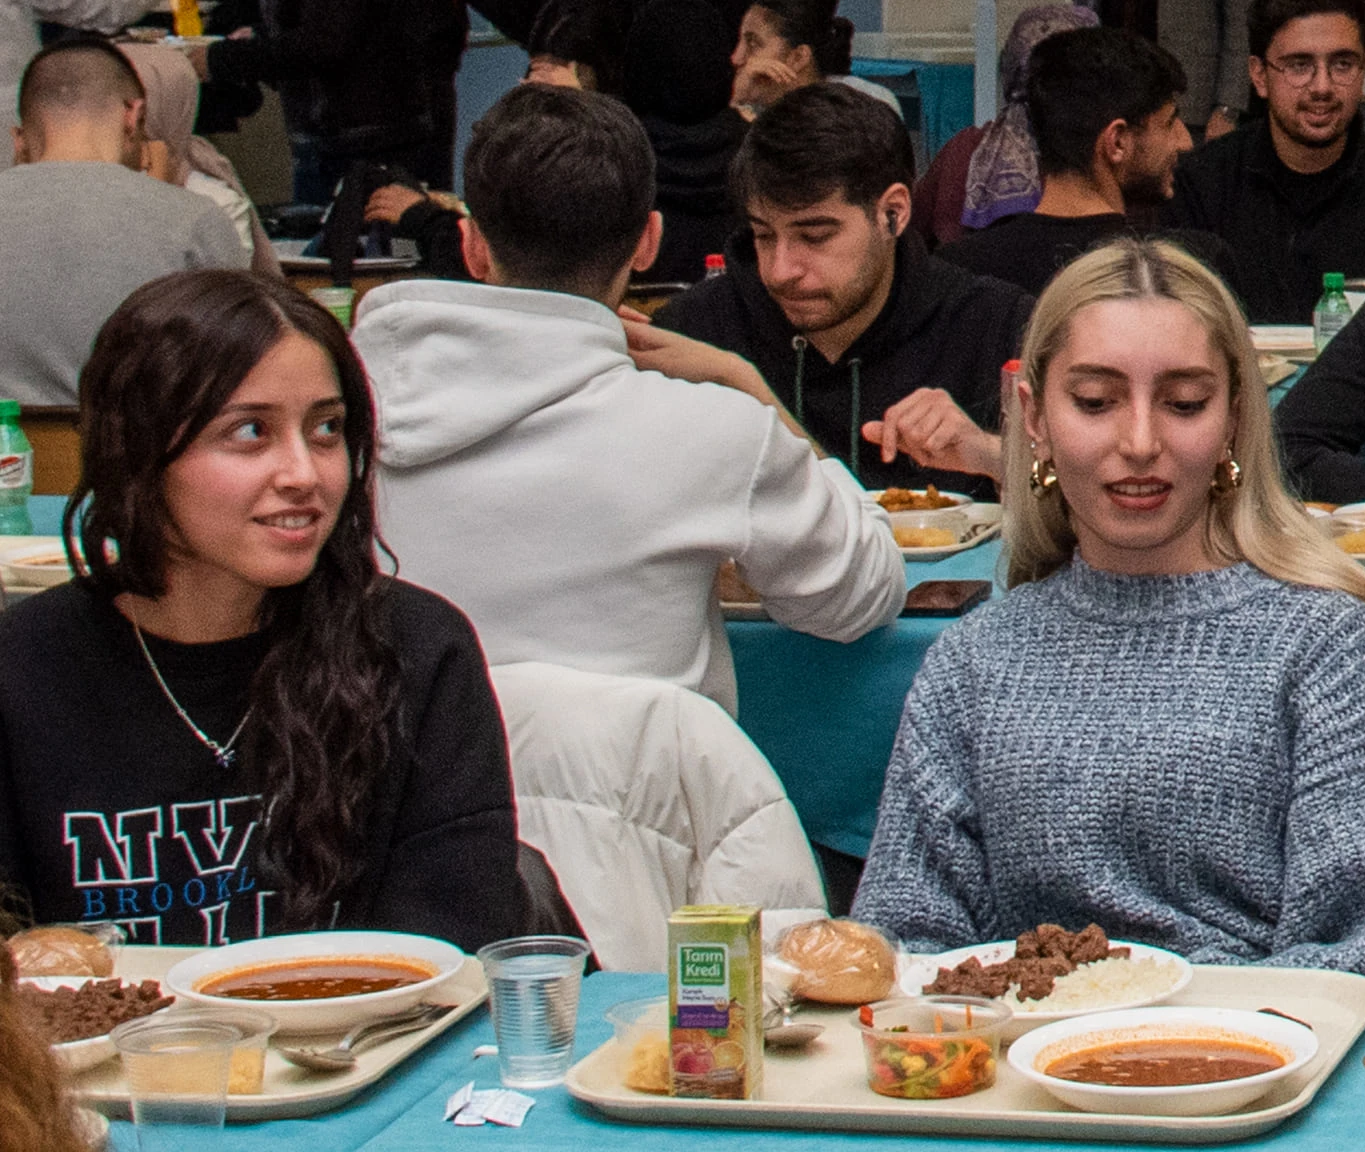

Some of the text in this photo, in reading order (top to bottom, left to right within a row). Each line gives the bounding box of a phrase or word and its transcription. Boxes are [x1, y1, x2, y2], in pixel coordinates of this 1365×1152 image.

[82, 865, 257, 918] BROOKL
[683, 948, 724, 962] Tarım
[685, 963, 721, 977] Kredi
